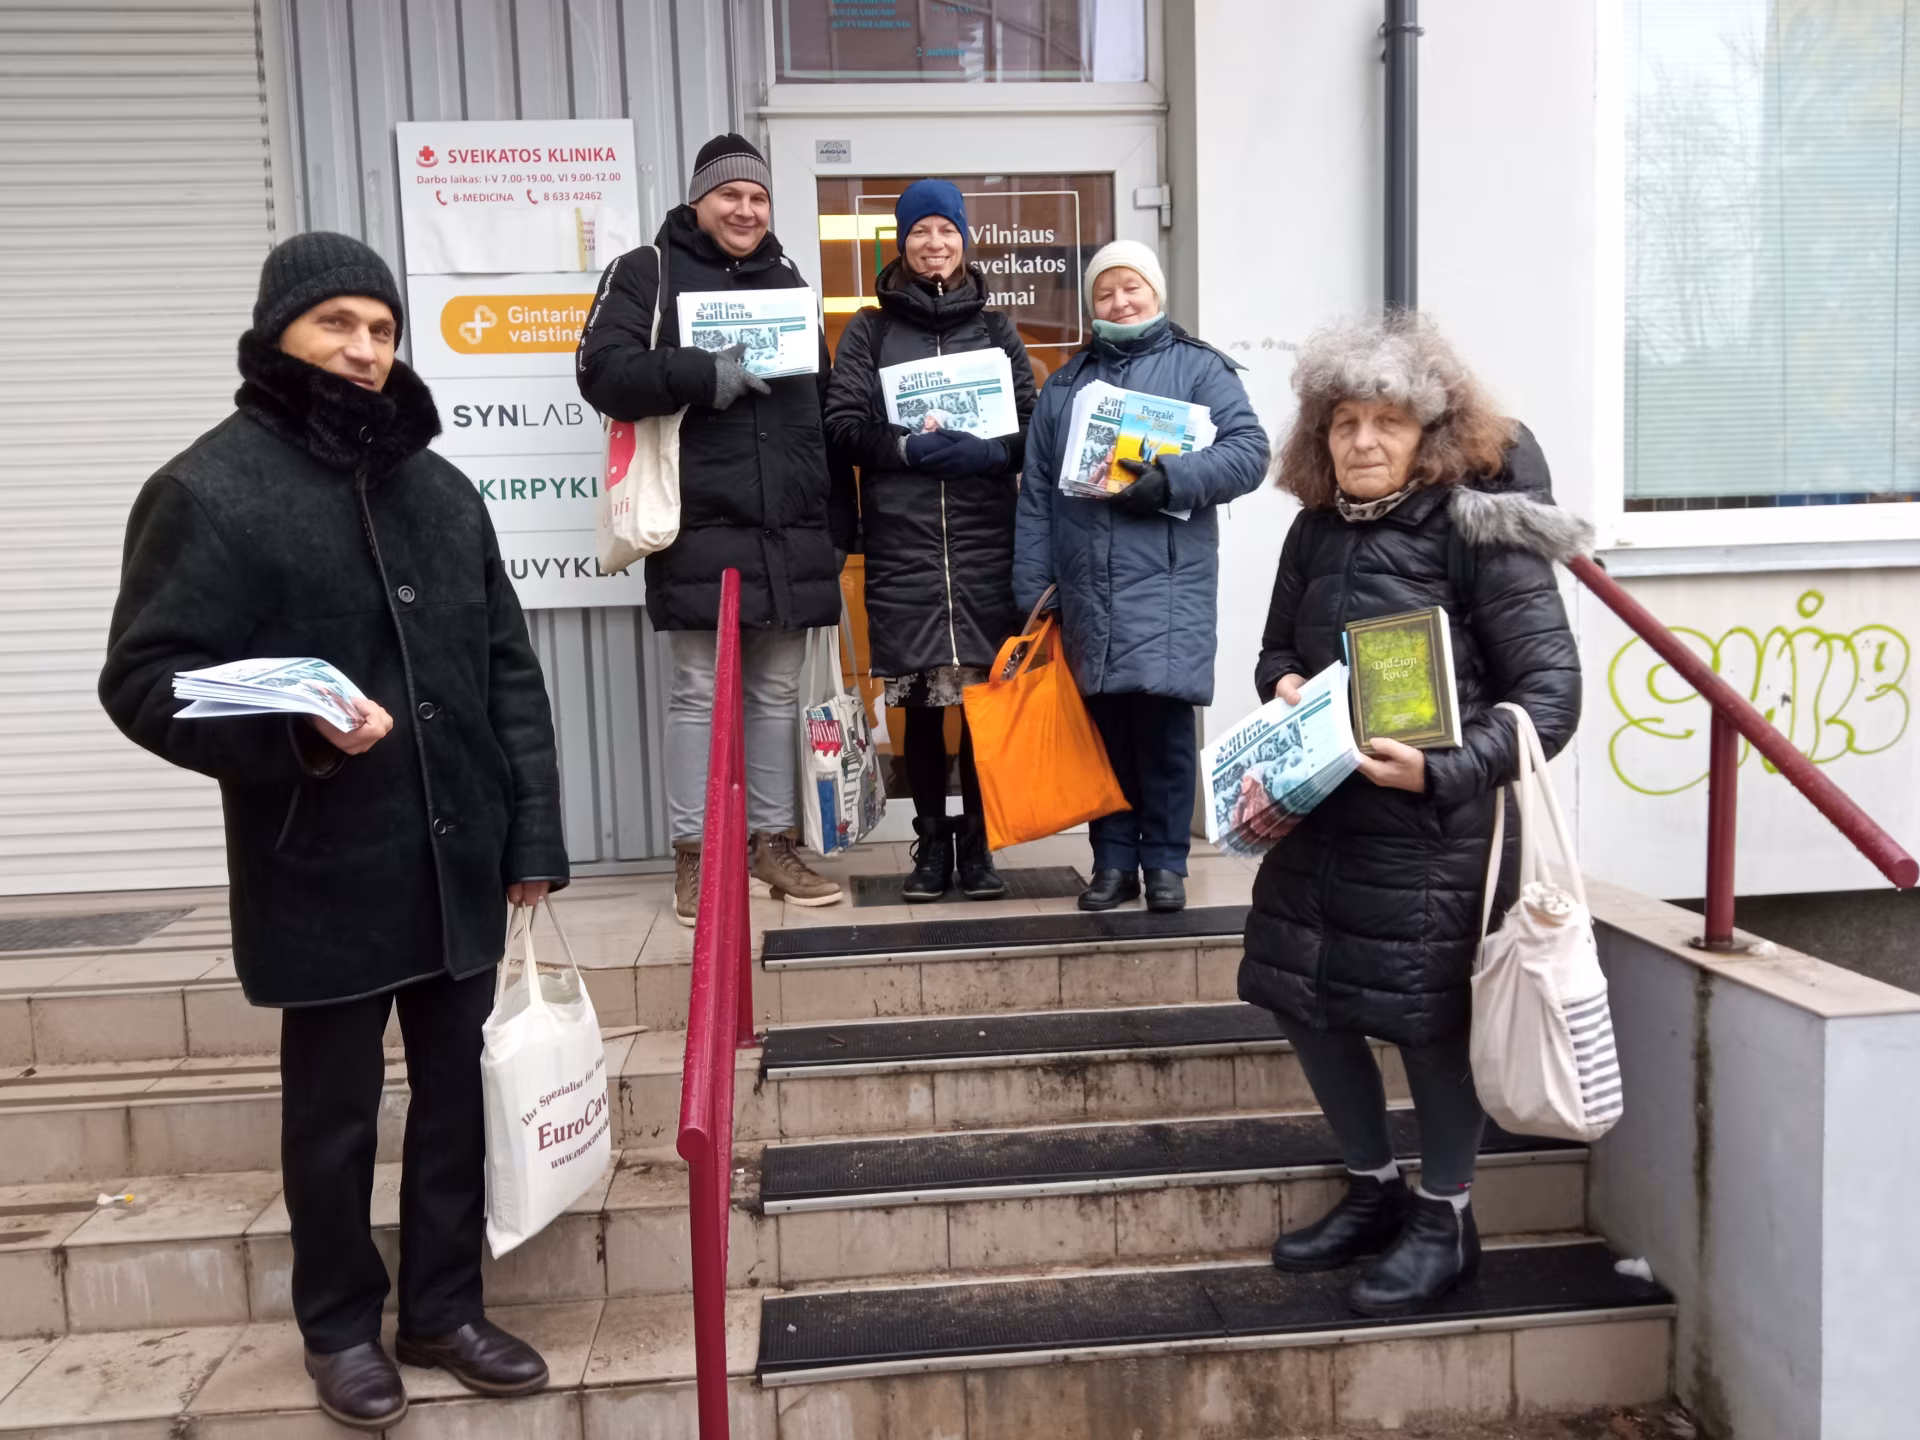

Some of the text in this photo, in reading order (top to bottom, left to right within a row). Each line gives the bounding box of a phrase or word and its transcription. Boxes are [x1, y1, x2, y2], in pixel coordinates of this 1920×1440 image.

[448, 147, 617, 163] SVEIKATOS KLINIKA
[416, 175, 448, 184] Darbo
[571, 172, 621, 182] 9.00-12.00
[452, 193, 514, 203] 8-MEDICINA
[543, 191, 602, 202] 8 633 42462
[968, 223, 1055, 245] Vilniaus
[970, 253, 1067, 275] sveikatos
[985, 284, 1036, 306] amai
[507, 305, 588, 324] Gintarin
[453, 403, 584, 428] SYNLAB
[478, 476, 598, 501] KIRPYK
[501, 556, 631, 580] UVYKL
[539, 1079, 584, 1108] Spezialist
[537, 1087, 609, 1152] EuroCav
